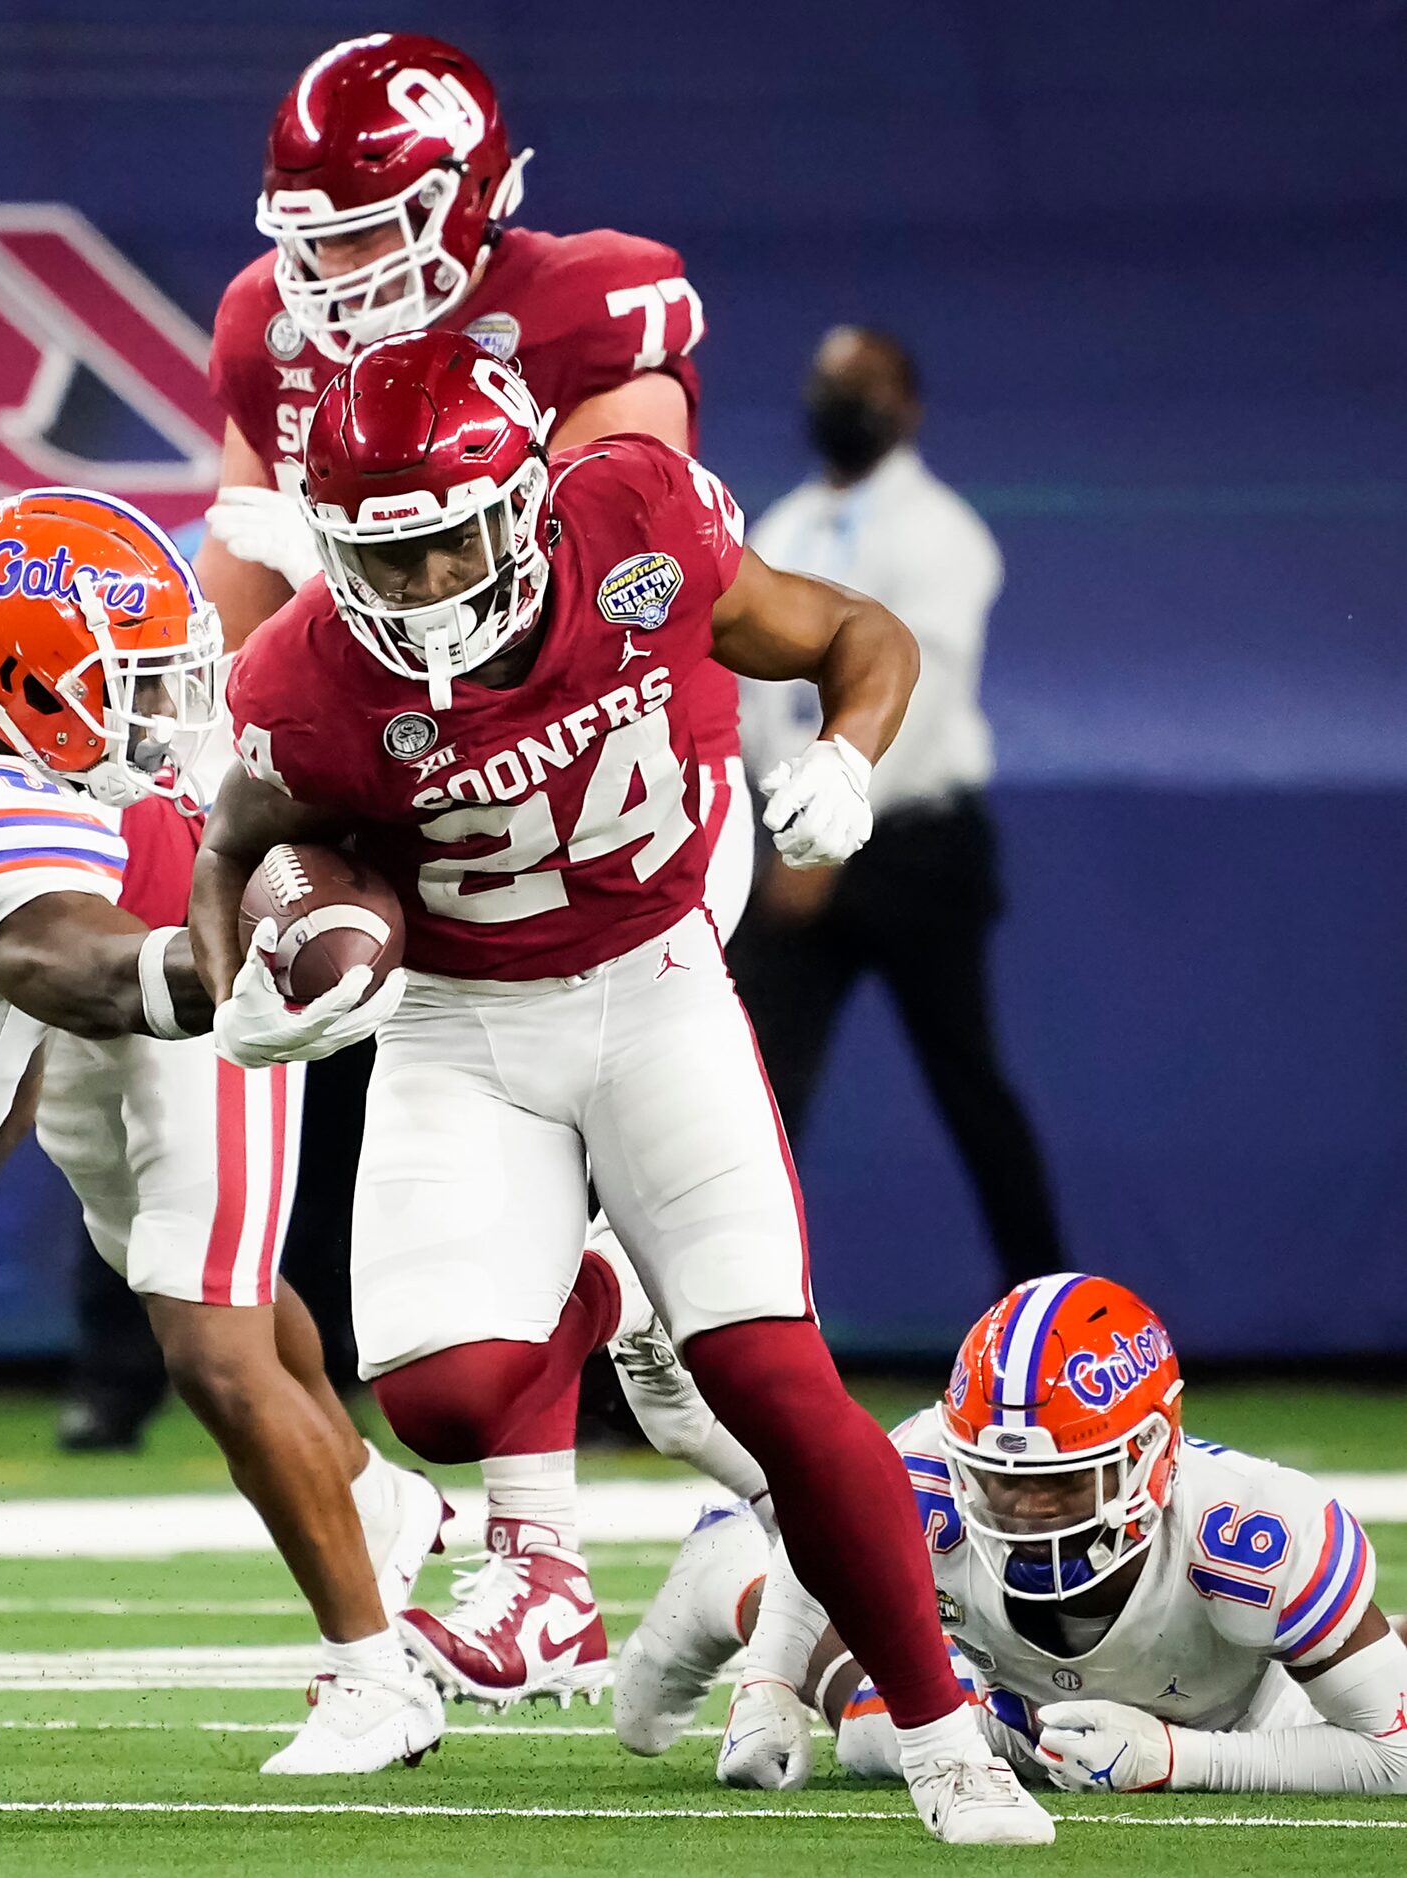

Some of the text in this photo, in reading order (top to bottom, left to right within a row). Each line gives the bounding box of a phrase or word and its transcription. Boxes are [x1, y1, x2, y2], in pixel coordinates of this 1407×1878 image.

[386, 67, 485, 150] OU
[605, 276, 705, 371] 77
[605, 563, 677, 614] COTTON
[411, 667, 674, 810] SOONERS
[417, 705, 697, 924] 24
[1187, 1501, 1292, 1610] 16
